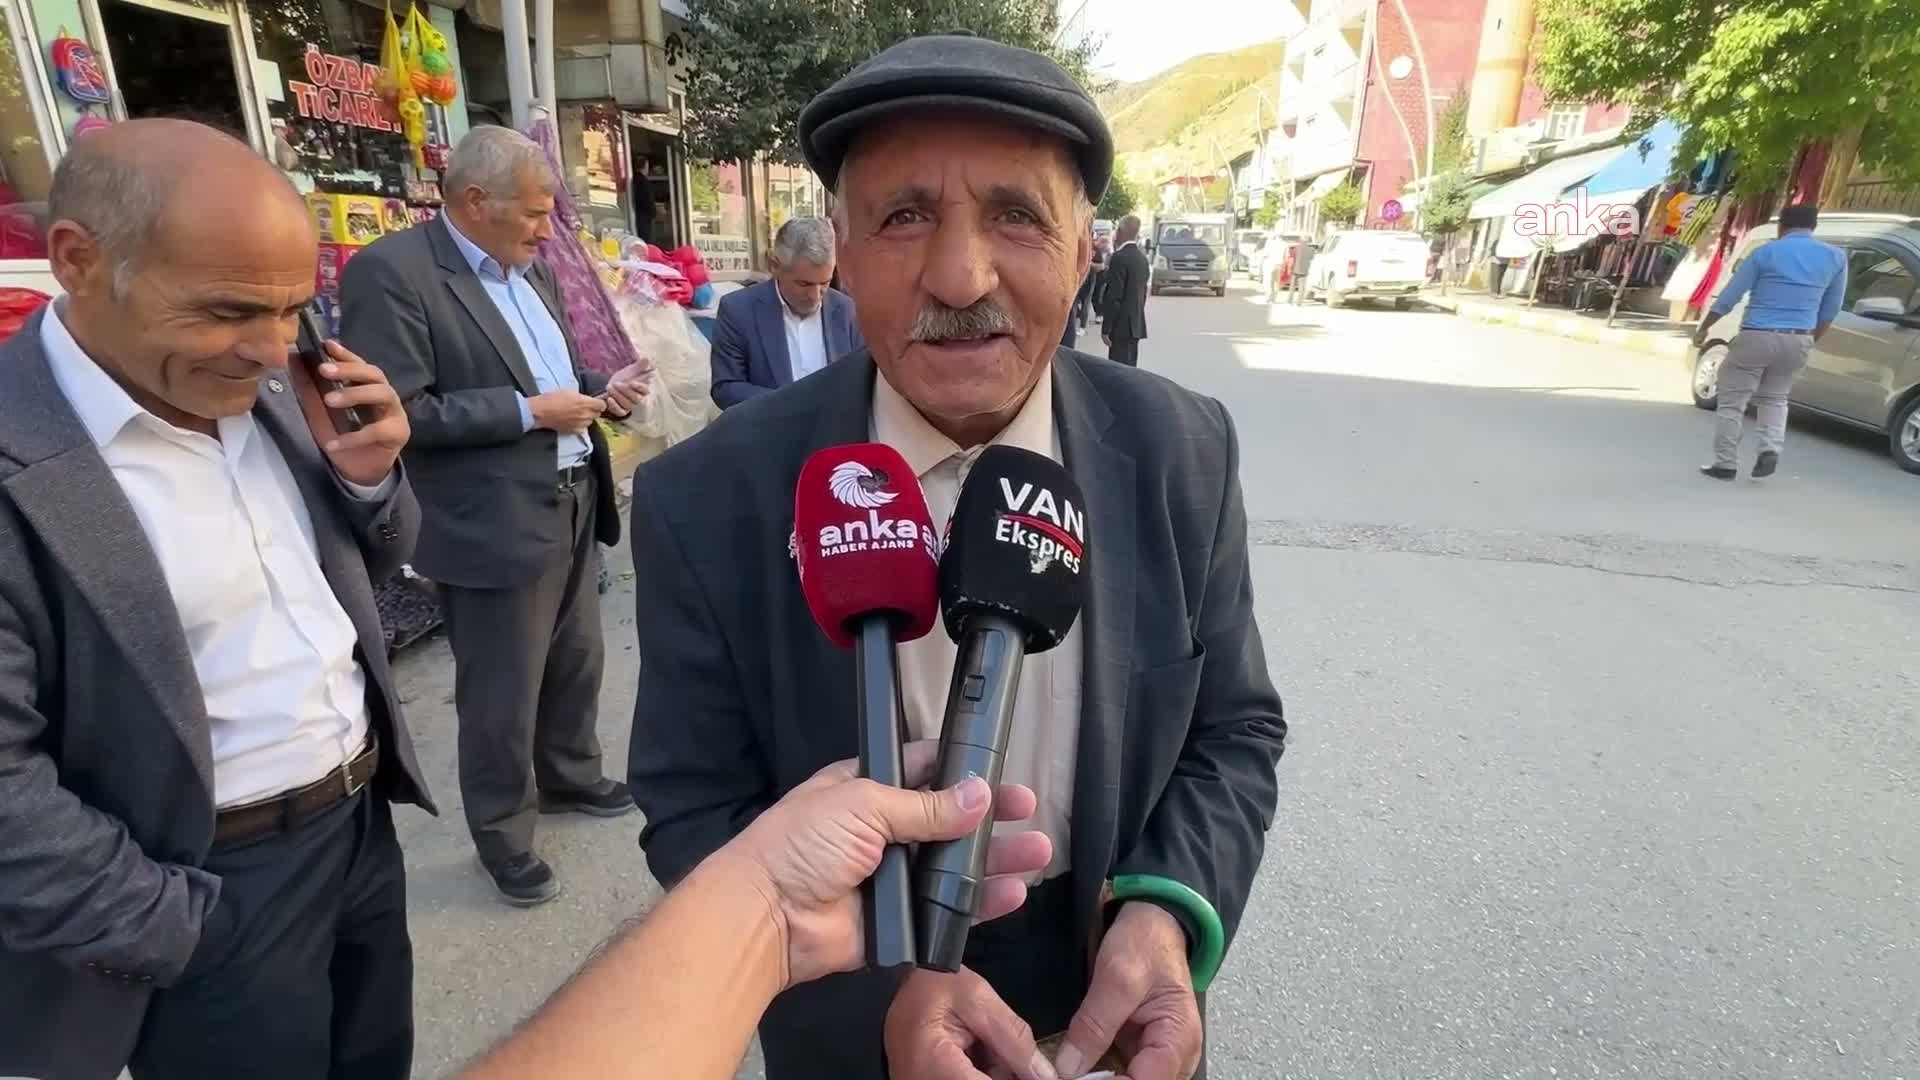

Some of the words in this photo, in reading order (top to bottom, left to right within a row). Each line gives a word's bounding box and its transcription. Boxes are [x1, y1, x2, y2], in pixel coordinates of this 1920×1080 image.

[305, 42, 388, 97] ÖZBA
[819, 509, 919, 547] anka
[1000, 477, 1084, 544] VAN
[821, 542, 867, 558] HABER
[871, 540, 914, 550] AJANS
[995, 519, 1081, 575] Ekspres
